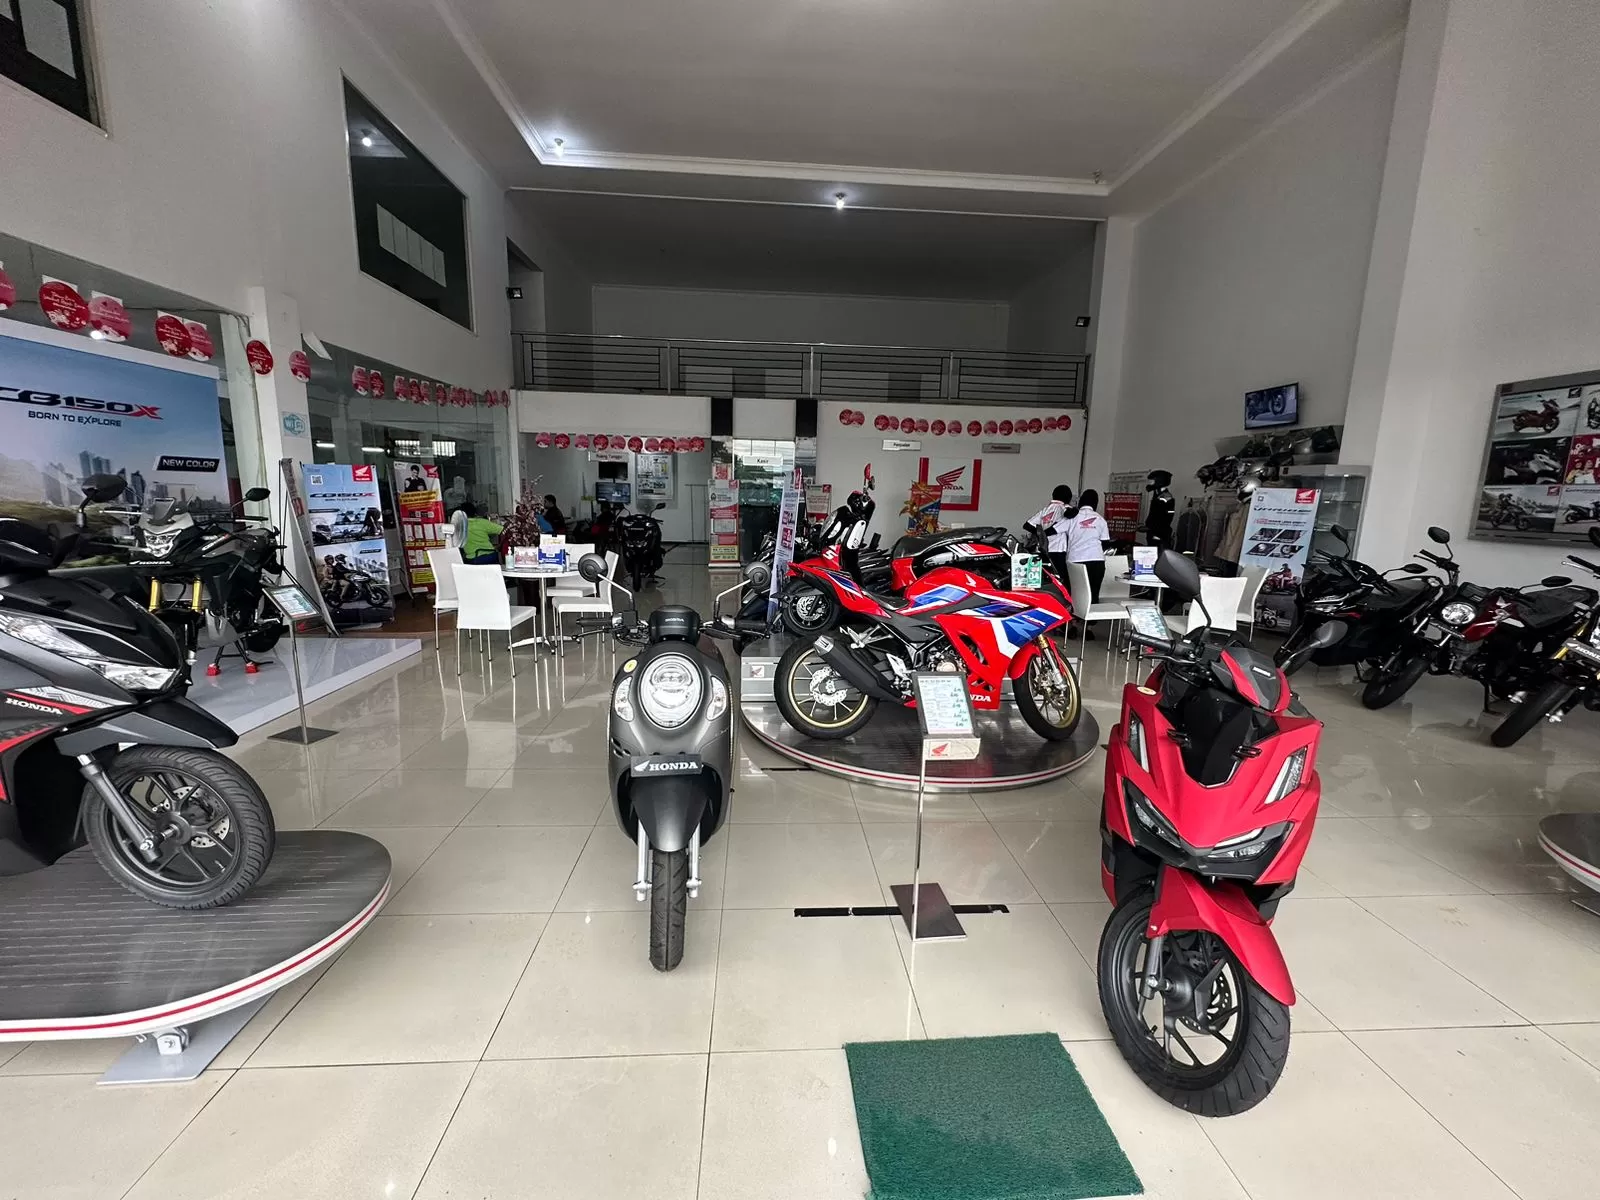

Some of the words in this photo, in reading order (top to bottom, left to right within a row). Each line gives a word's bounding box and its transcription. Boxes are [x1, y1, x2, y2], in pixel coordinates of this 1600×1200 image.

[28, 410, 60, 420] BORN
[62, 414, 76, 422] TO
[77, 415, 122, 427] EXPLORE
[162, 459, 184, 467] NEW
[186, 460, 216, 468] COLOR
[969, 693, 992, 702] NDA
[5, 697, 63, 715] HONDA
[649, 761, 698, 772] HONDA
